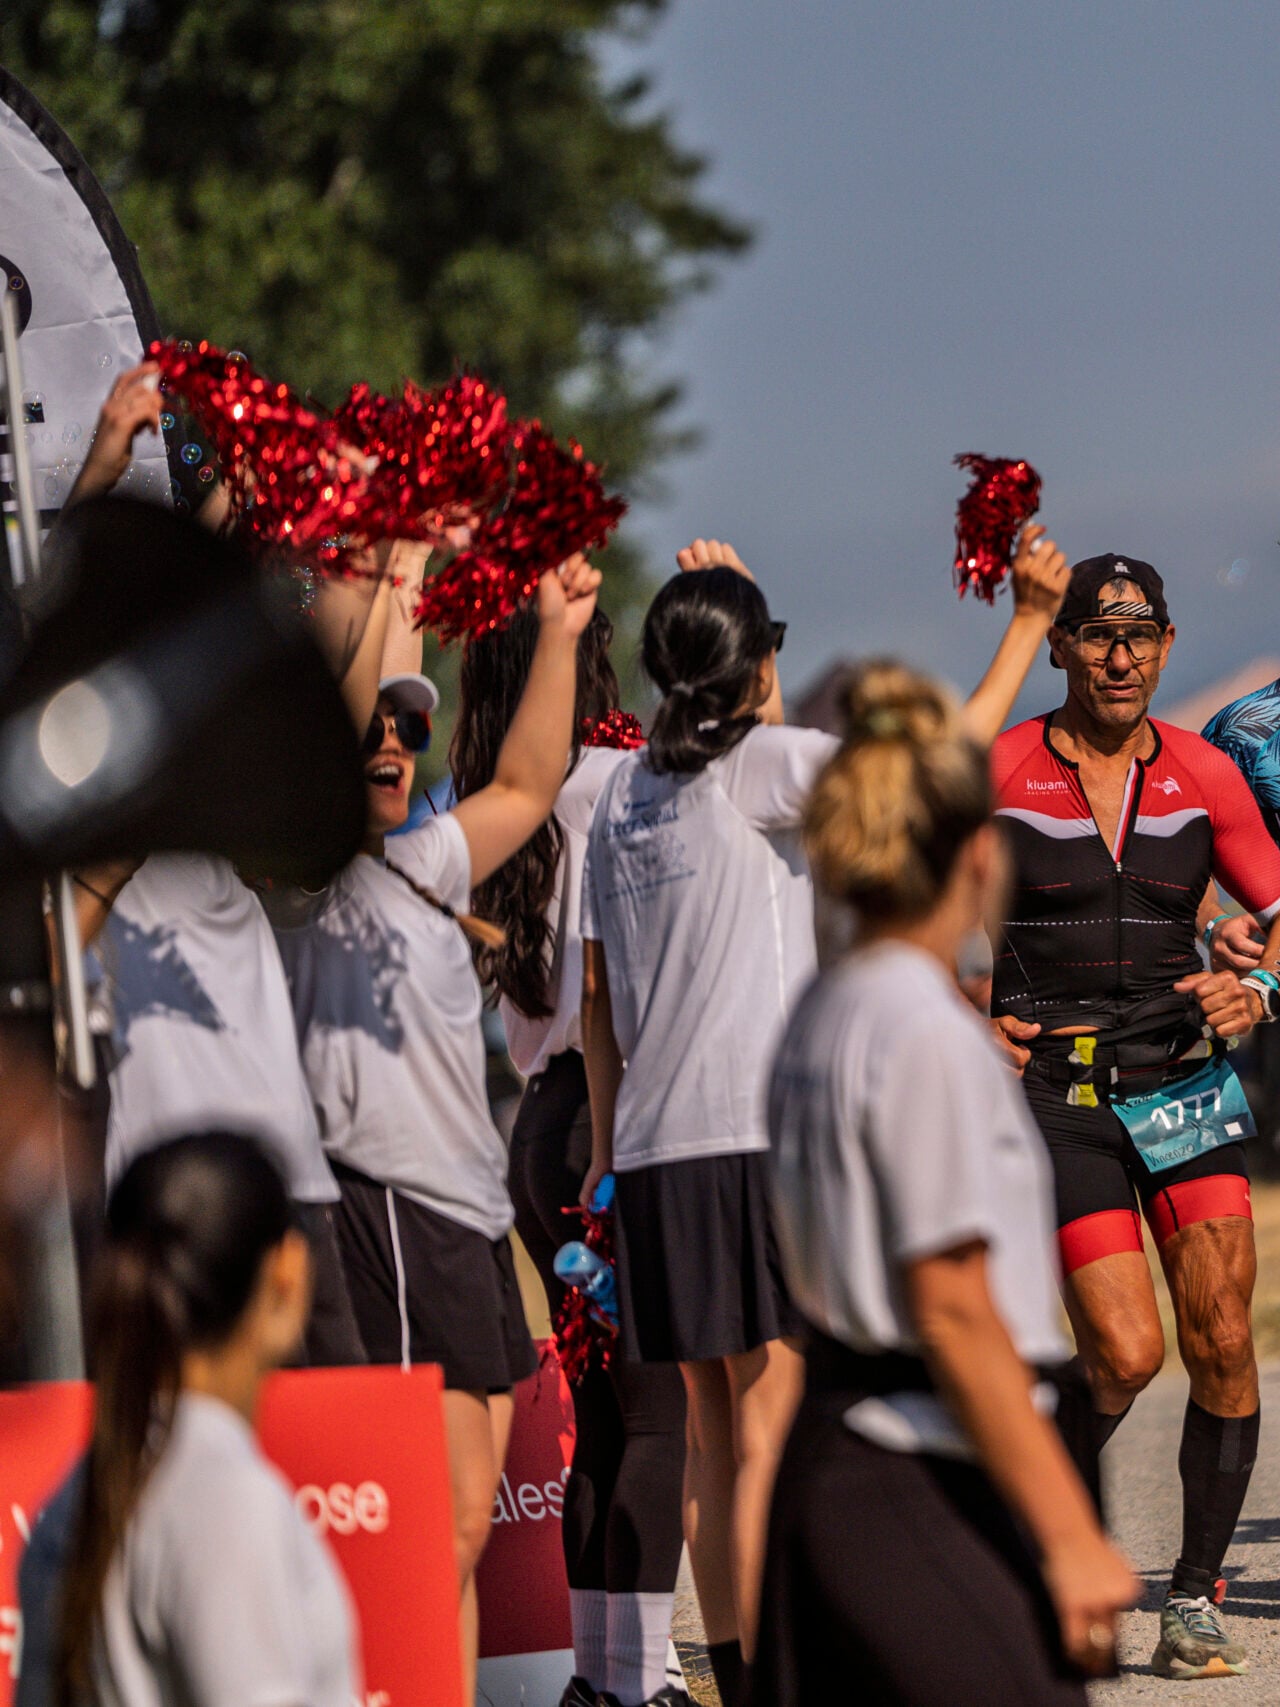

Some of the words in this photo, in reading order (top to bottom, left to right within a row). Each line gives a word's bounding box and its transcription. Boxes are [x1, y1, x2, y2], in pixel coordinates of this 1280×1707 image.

[1026, 778, 1069, 791] kiwami
[1150, 1086, 1221, 1131] 1777
[1145, 1142, 1195, 1168] Vincenzo
